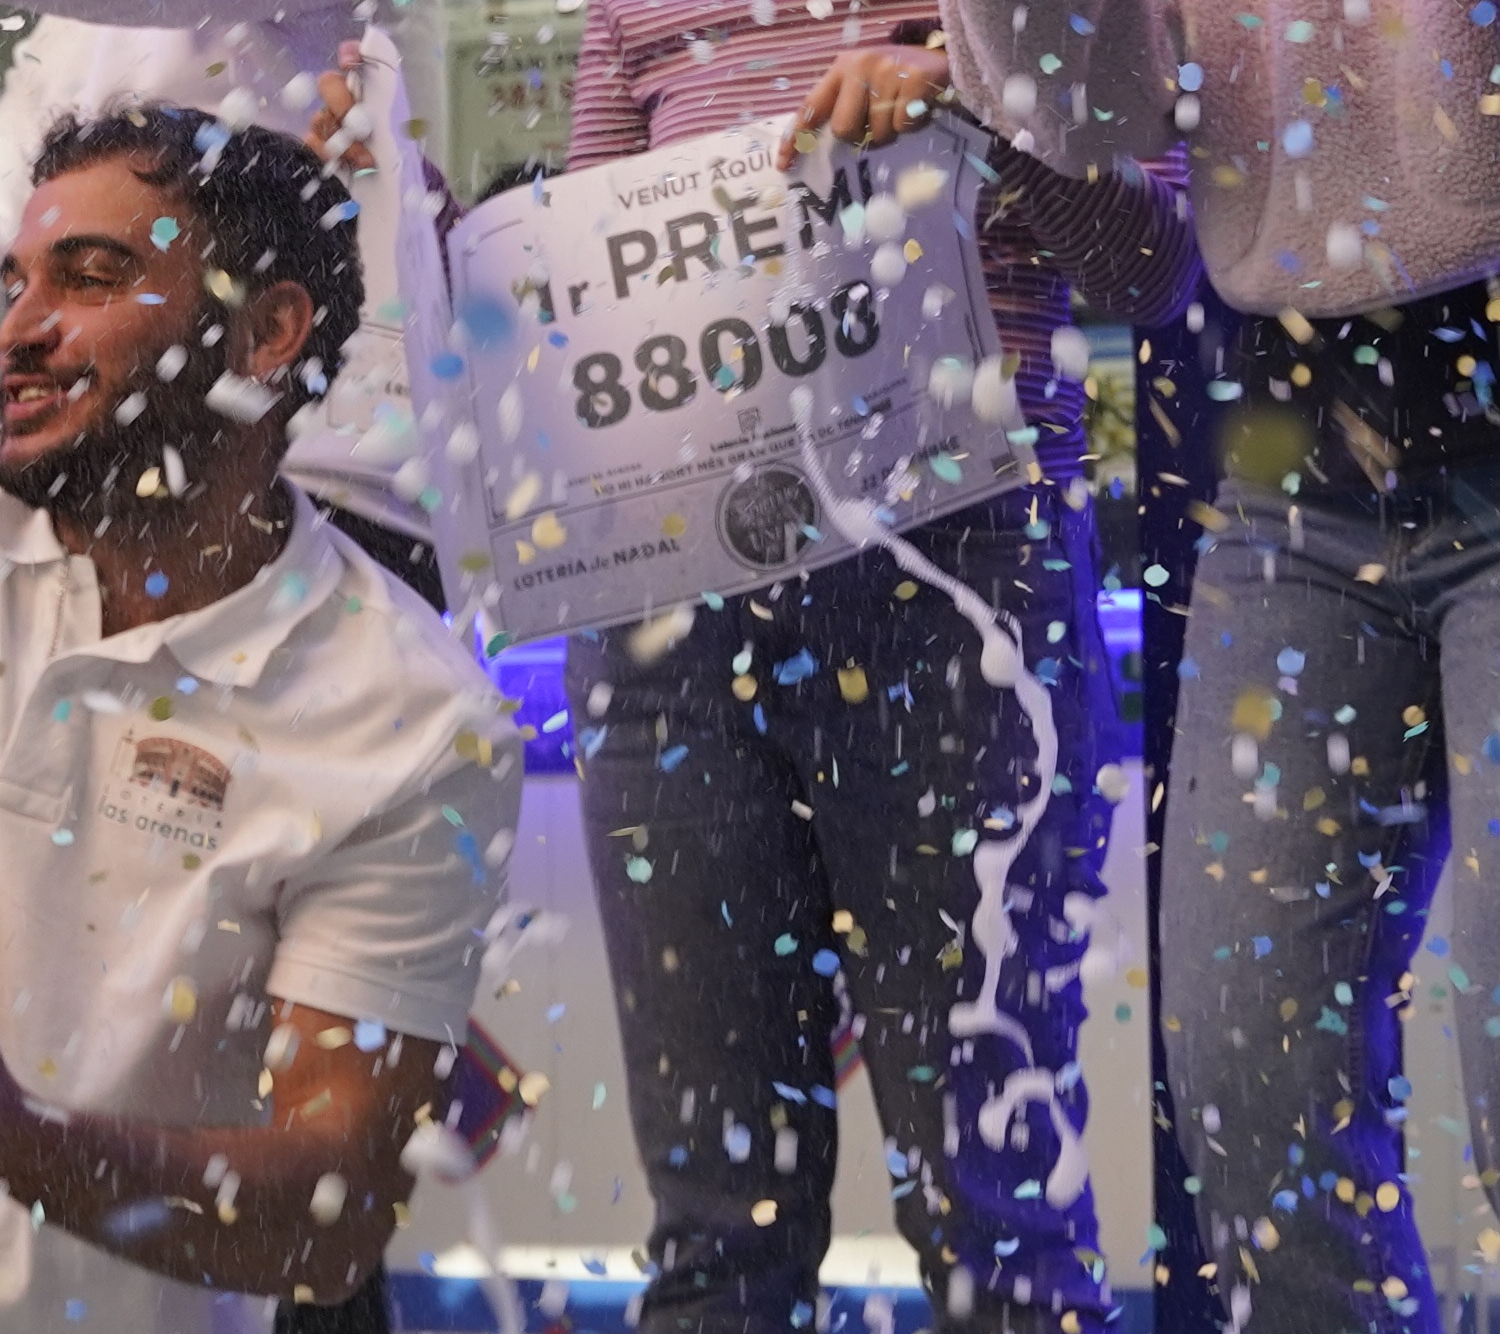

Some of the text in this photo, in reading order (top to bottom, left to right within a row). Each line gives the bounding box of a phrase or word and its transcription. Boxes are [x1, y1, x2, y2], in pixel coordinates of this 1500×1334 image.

[617, 174, 699, 211] VENUT
[606, 158, 876, 301] PREMI
[572, 279, 882, 431] 88008
[612, 538, 681, 567] NADAL
[99, 794, 219, 851] las arenas
